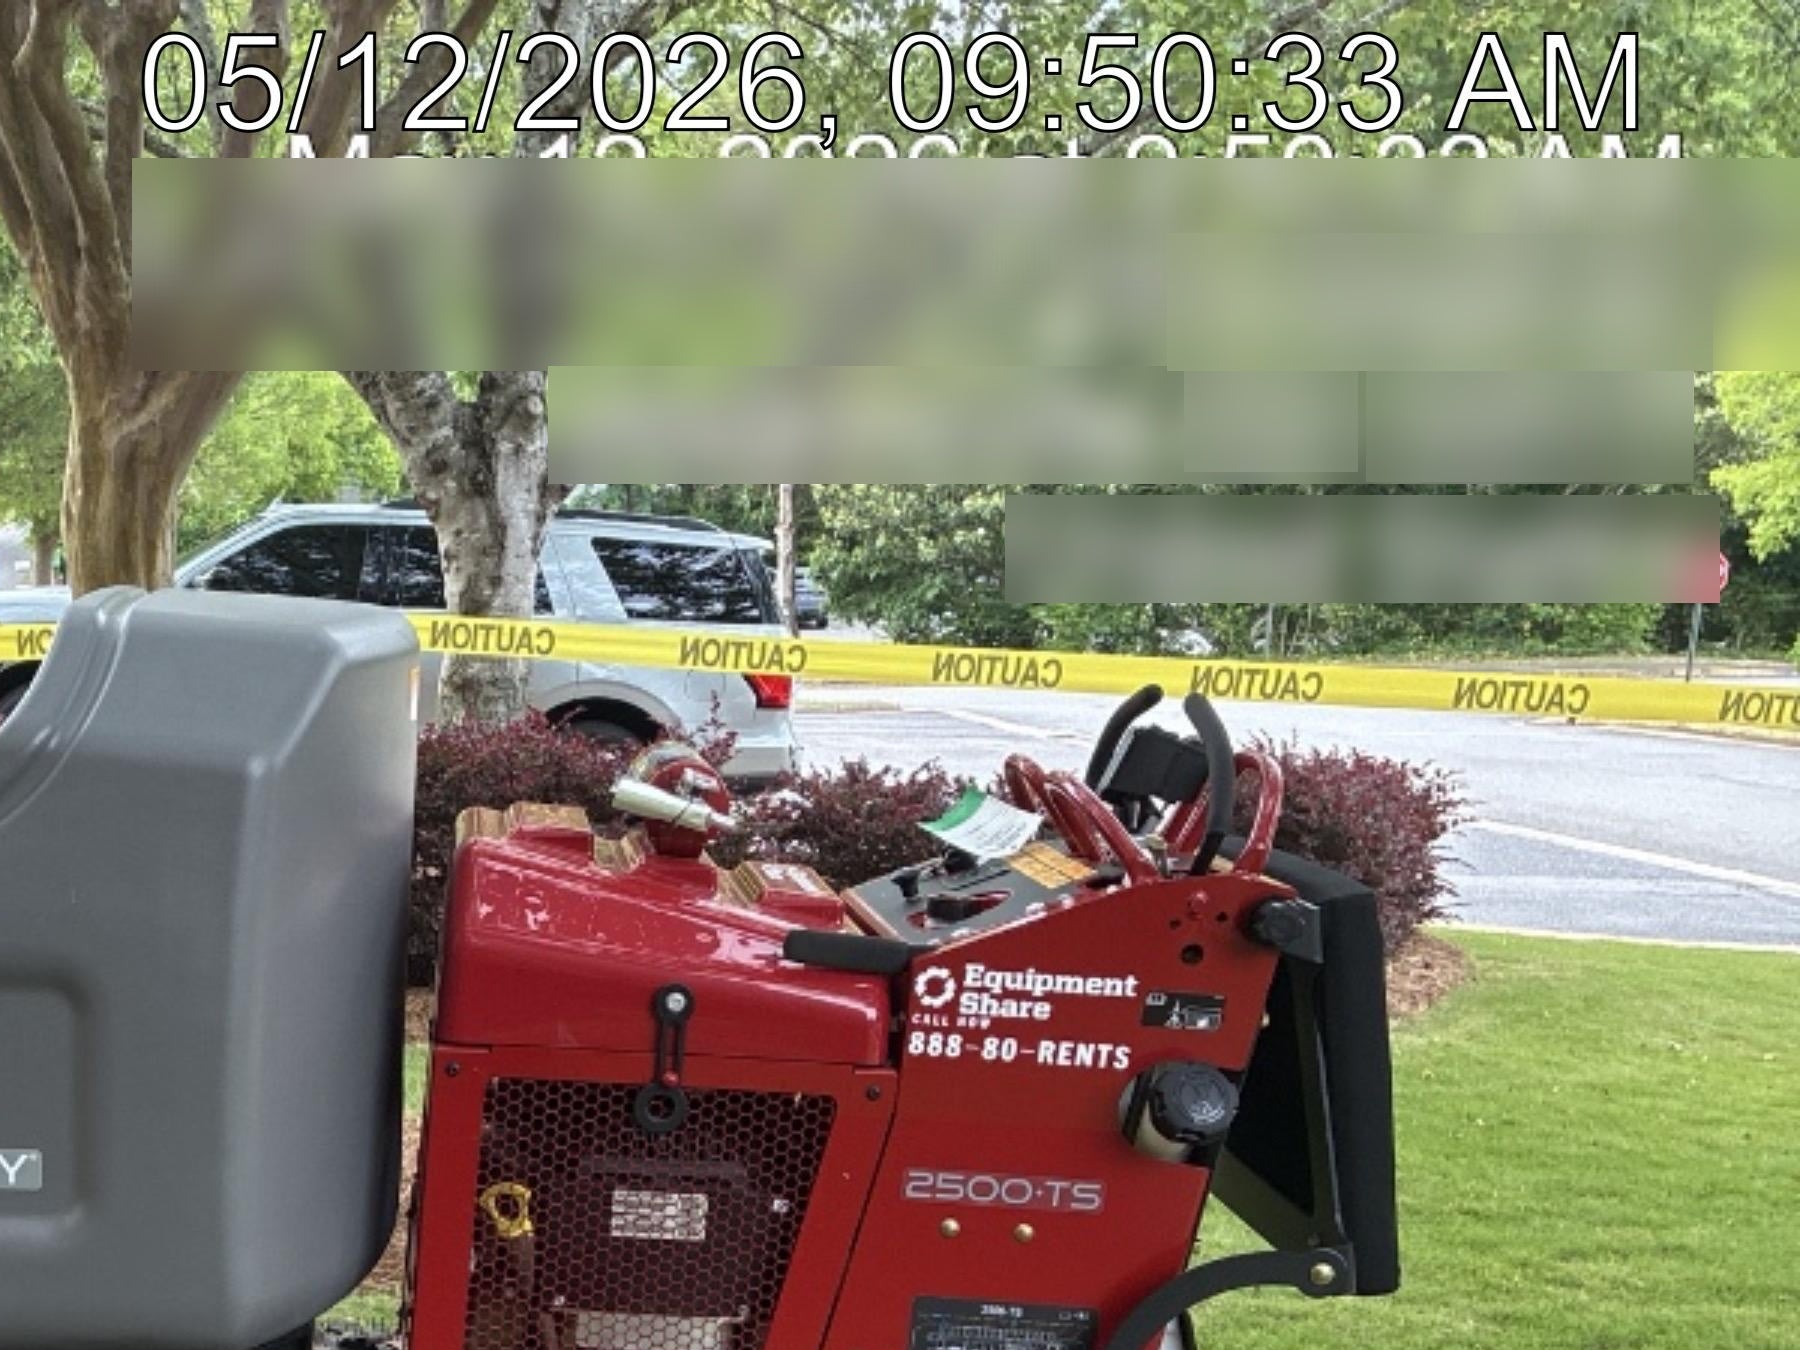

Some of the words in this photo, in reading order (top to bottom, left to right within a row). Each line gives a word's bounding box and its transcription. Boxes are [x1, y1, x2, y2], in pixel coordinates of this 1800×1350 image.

[963, 963, 1139, 998] Equipment
[911, 1013, 949, 1027] CALL
[959, 992, 1051, 1019] Share
[908, 1031, 1132, 1070] 888-80-RENTS
